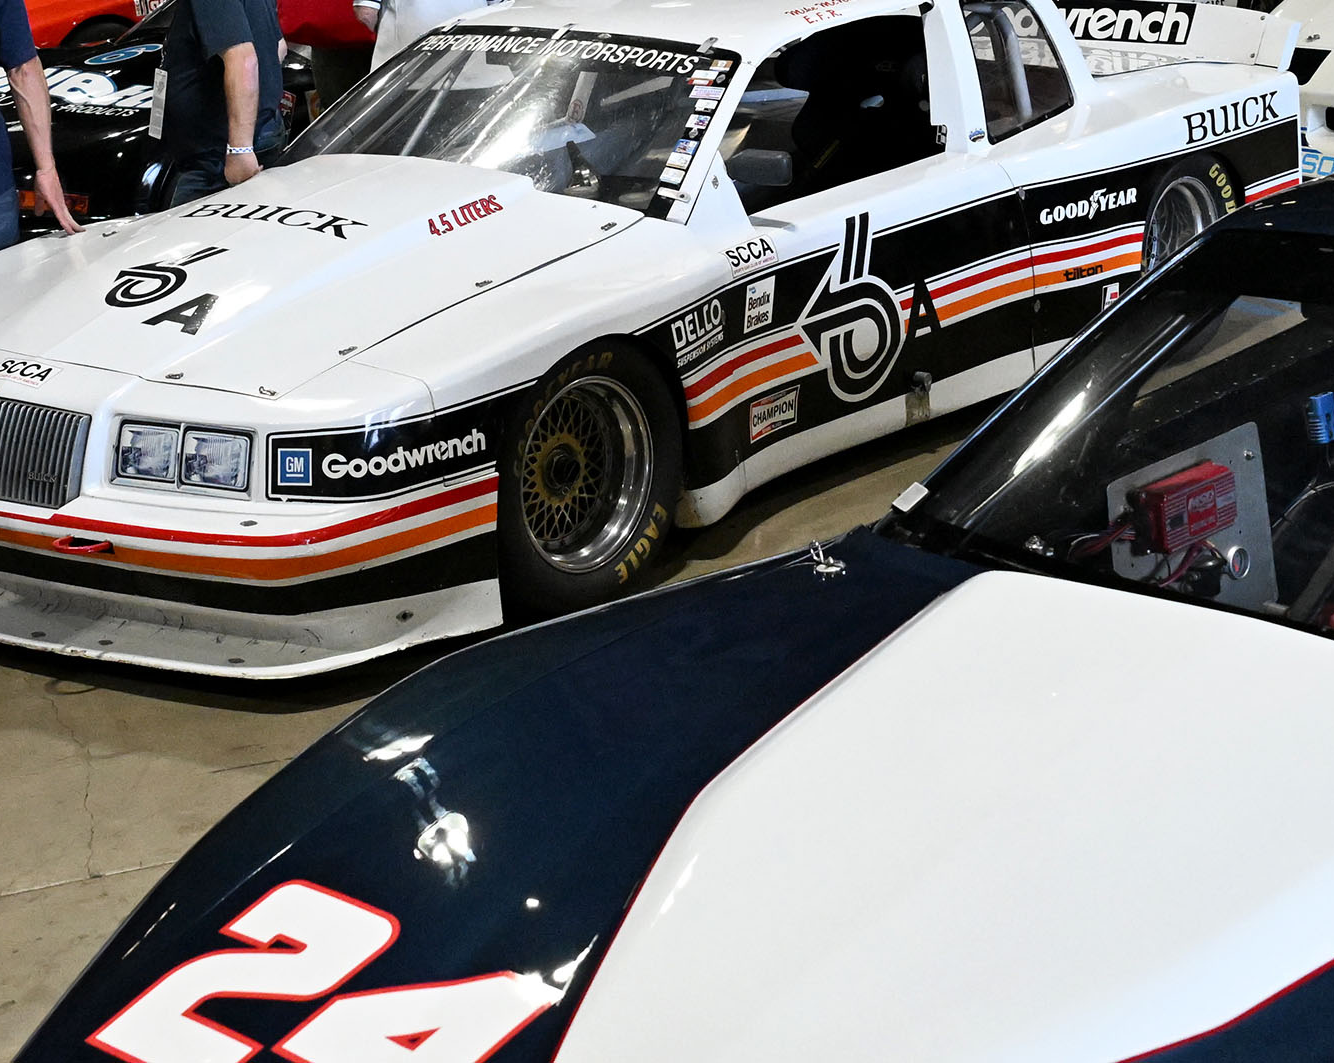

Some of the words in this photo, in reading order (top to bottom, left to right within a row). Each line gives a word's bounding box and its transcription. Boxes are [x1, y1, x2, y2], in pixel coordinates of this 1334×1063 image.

[413, 35, 547, 58] PERFORMANCE
[546, 39, 701, 76] MOTORSPORTS
[1183, 90, 1279, 145] BUICK
[183, 203, 369, 240] BUICK
[428, 212, 456, 237] 4.5
[455, 194, 504, 229] LITERS
[725, 238, 775, 268] SCCA
[1063, 264, 1104, 281] tilton
[748, 291, 772, 311] Bendix
[670, 299, 723, 349] DELCO
[747, 310, 769, 328] Brakes
[677, 342, 706, 369] SUSPENSION
[752, 398, 794, 427] CHAMPION
[285, 456, 306, 475] GM
[321, 427, 488, 481] Goodwrench
[27, 469, 58, 484] BUICK
[614, 500, 669, 586] EAGLE
